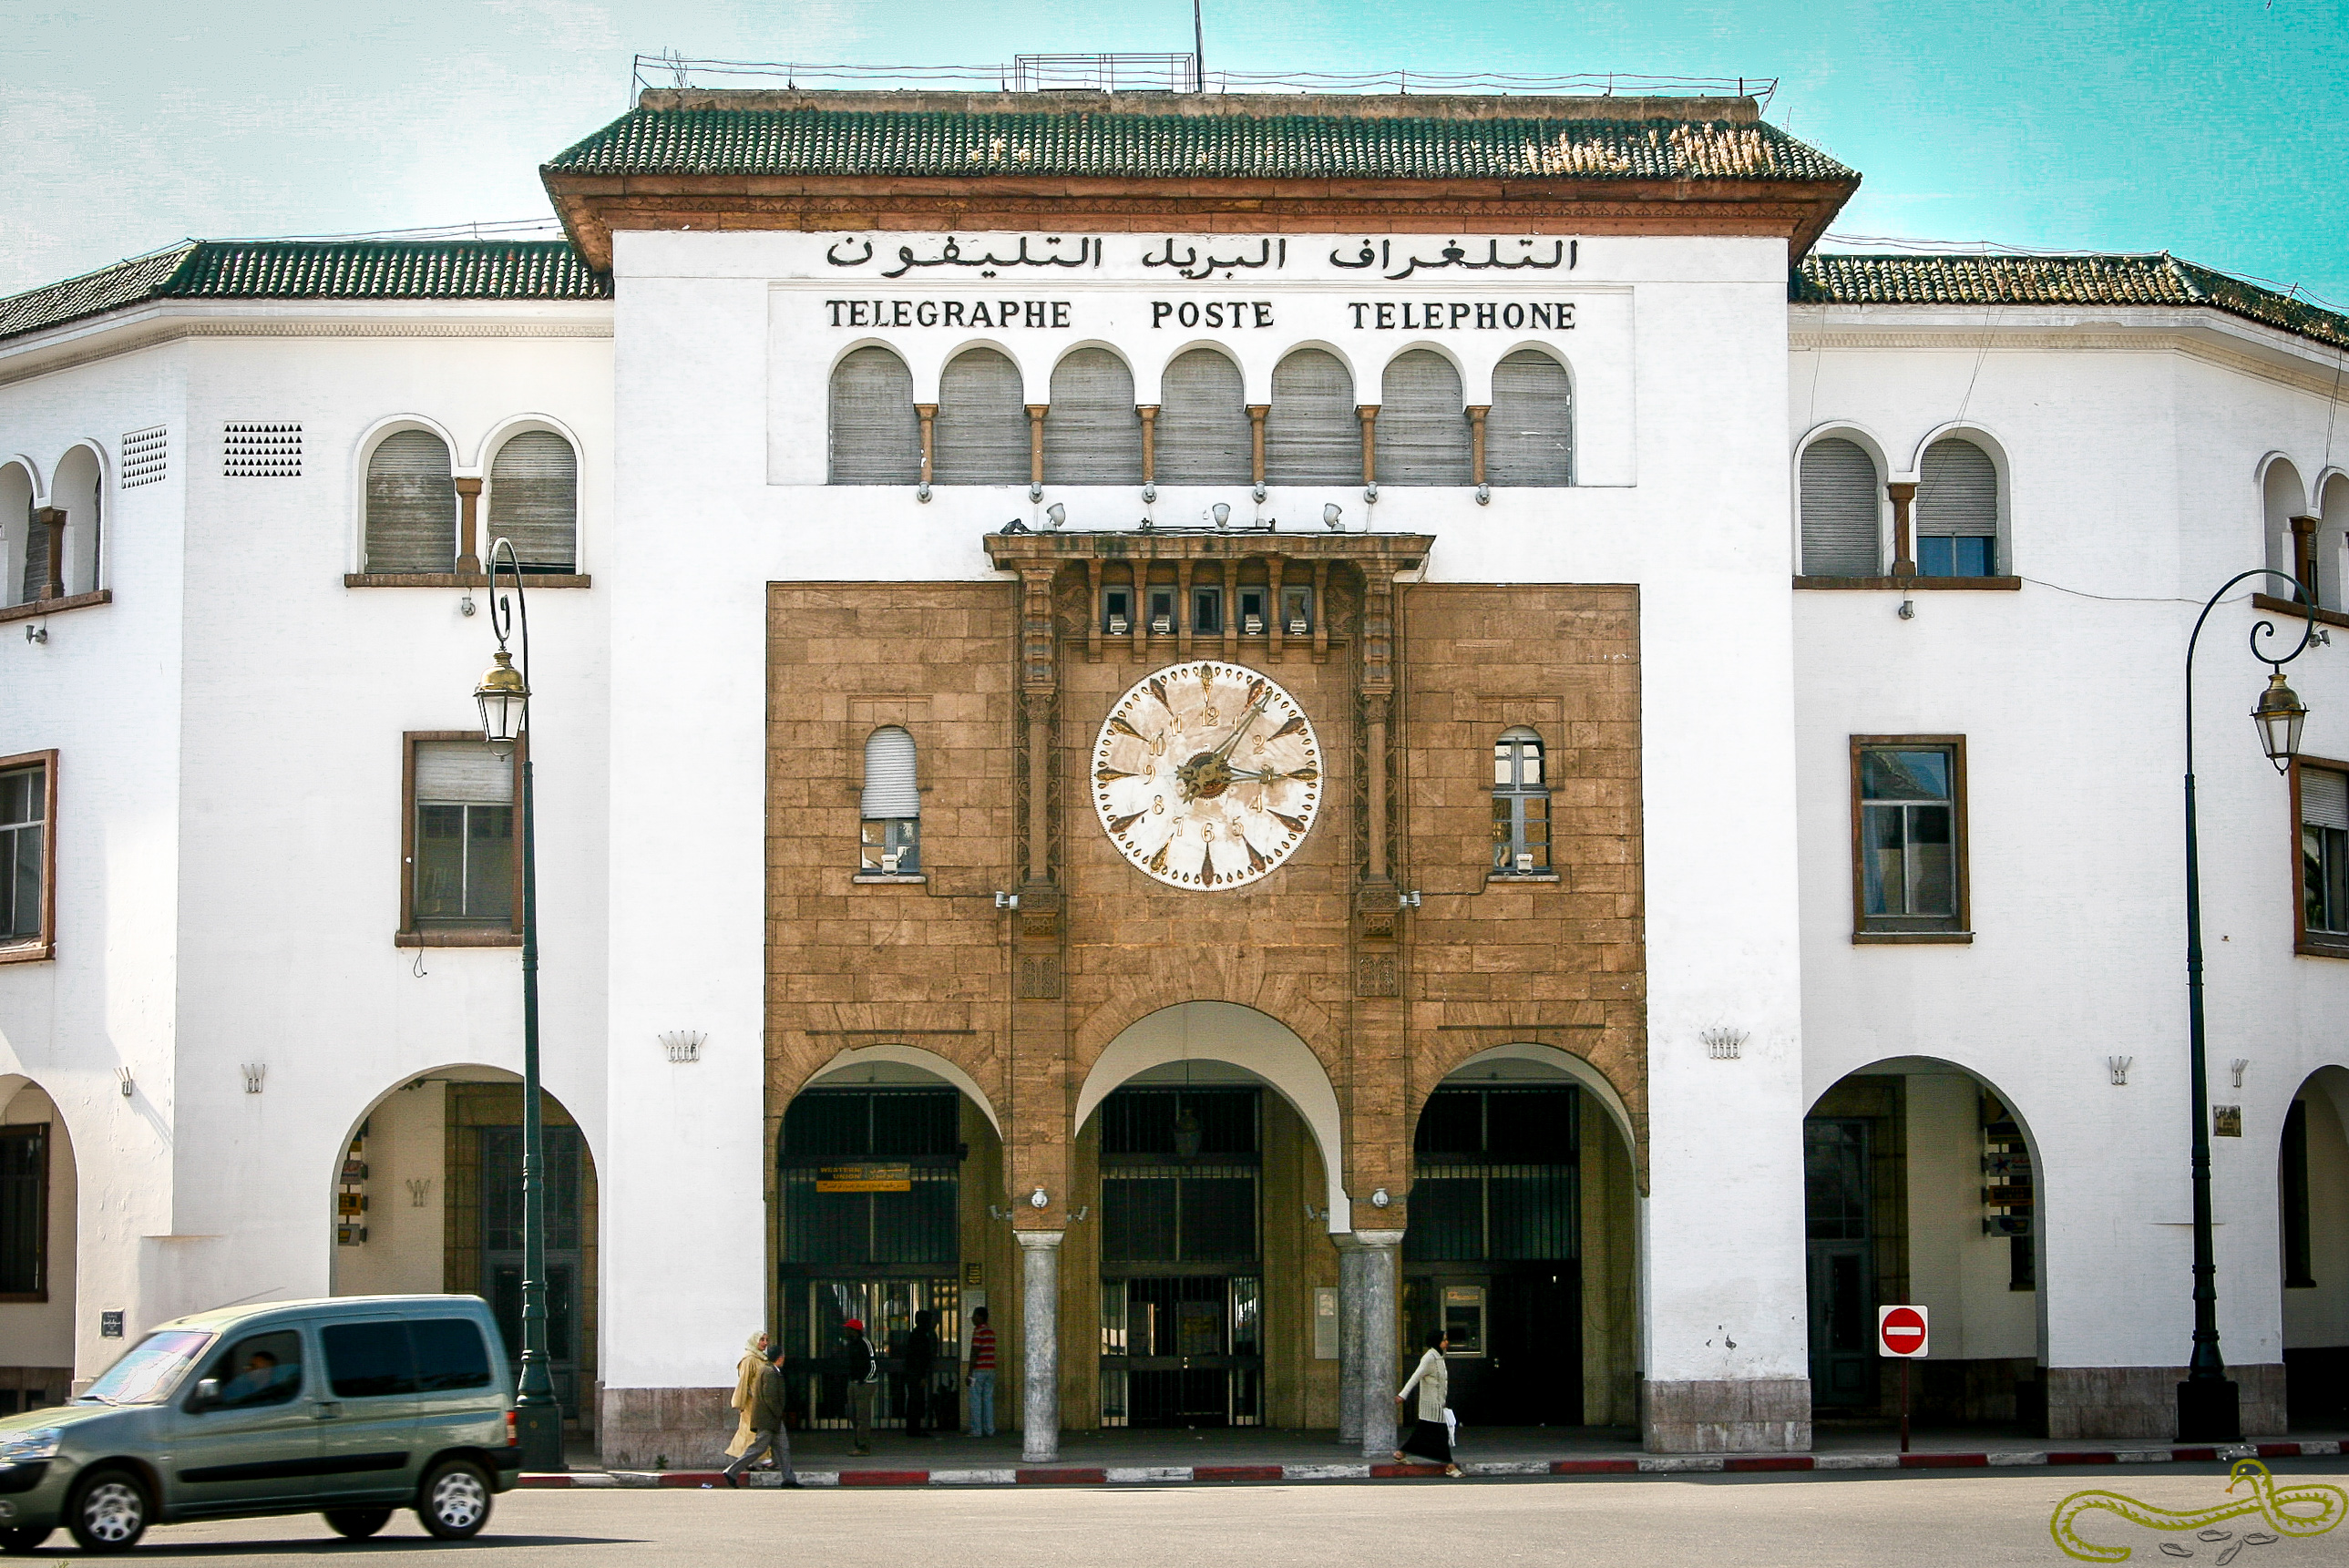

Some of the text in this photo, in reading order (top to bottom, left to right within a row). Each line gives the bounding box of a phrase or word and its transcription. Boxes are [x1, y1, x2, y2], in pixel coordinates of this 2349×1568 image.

[826, 235, 1578, 281] التلغراف البريد التليفون
[826, 300, 1576, 330] TELEGRAPHE POSTE TELEPHONE
[1169, 712, 1183, 736] 11
[1201, 707, 1220, 727] 12
[1233, 714, 1240, 733] 1
[1148, 736, 1166, 756] 10
[1252, 734, 1265, 755] 2
[1143, 764, 1156, 785] 9
[1152, 794, 1164, 815] 8
[1249, 792, 1263, 814] 4
[1172, 815, 1184, 836] 7
[1201, 822, 1216, 843] 6
[1232, 815, 1245, 837] 5
